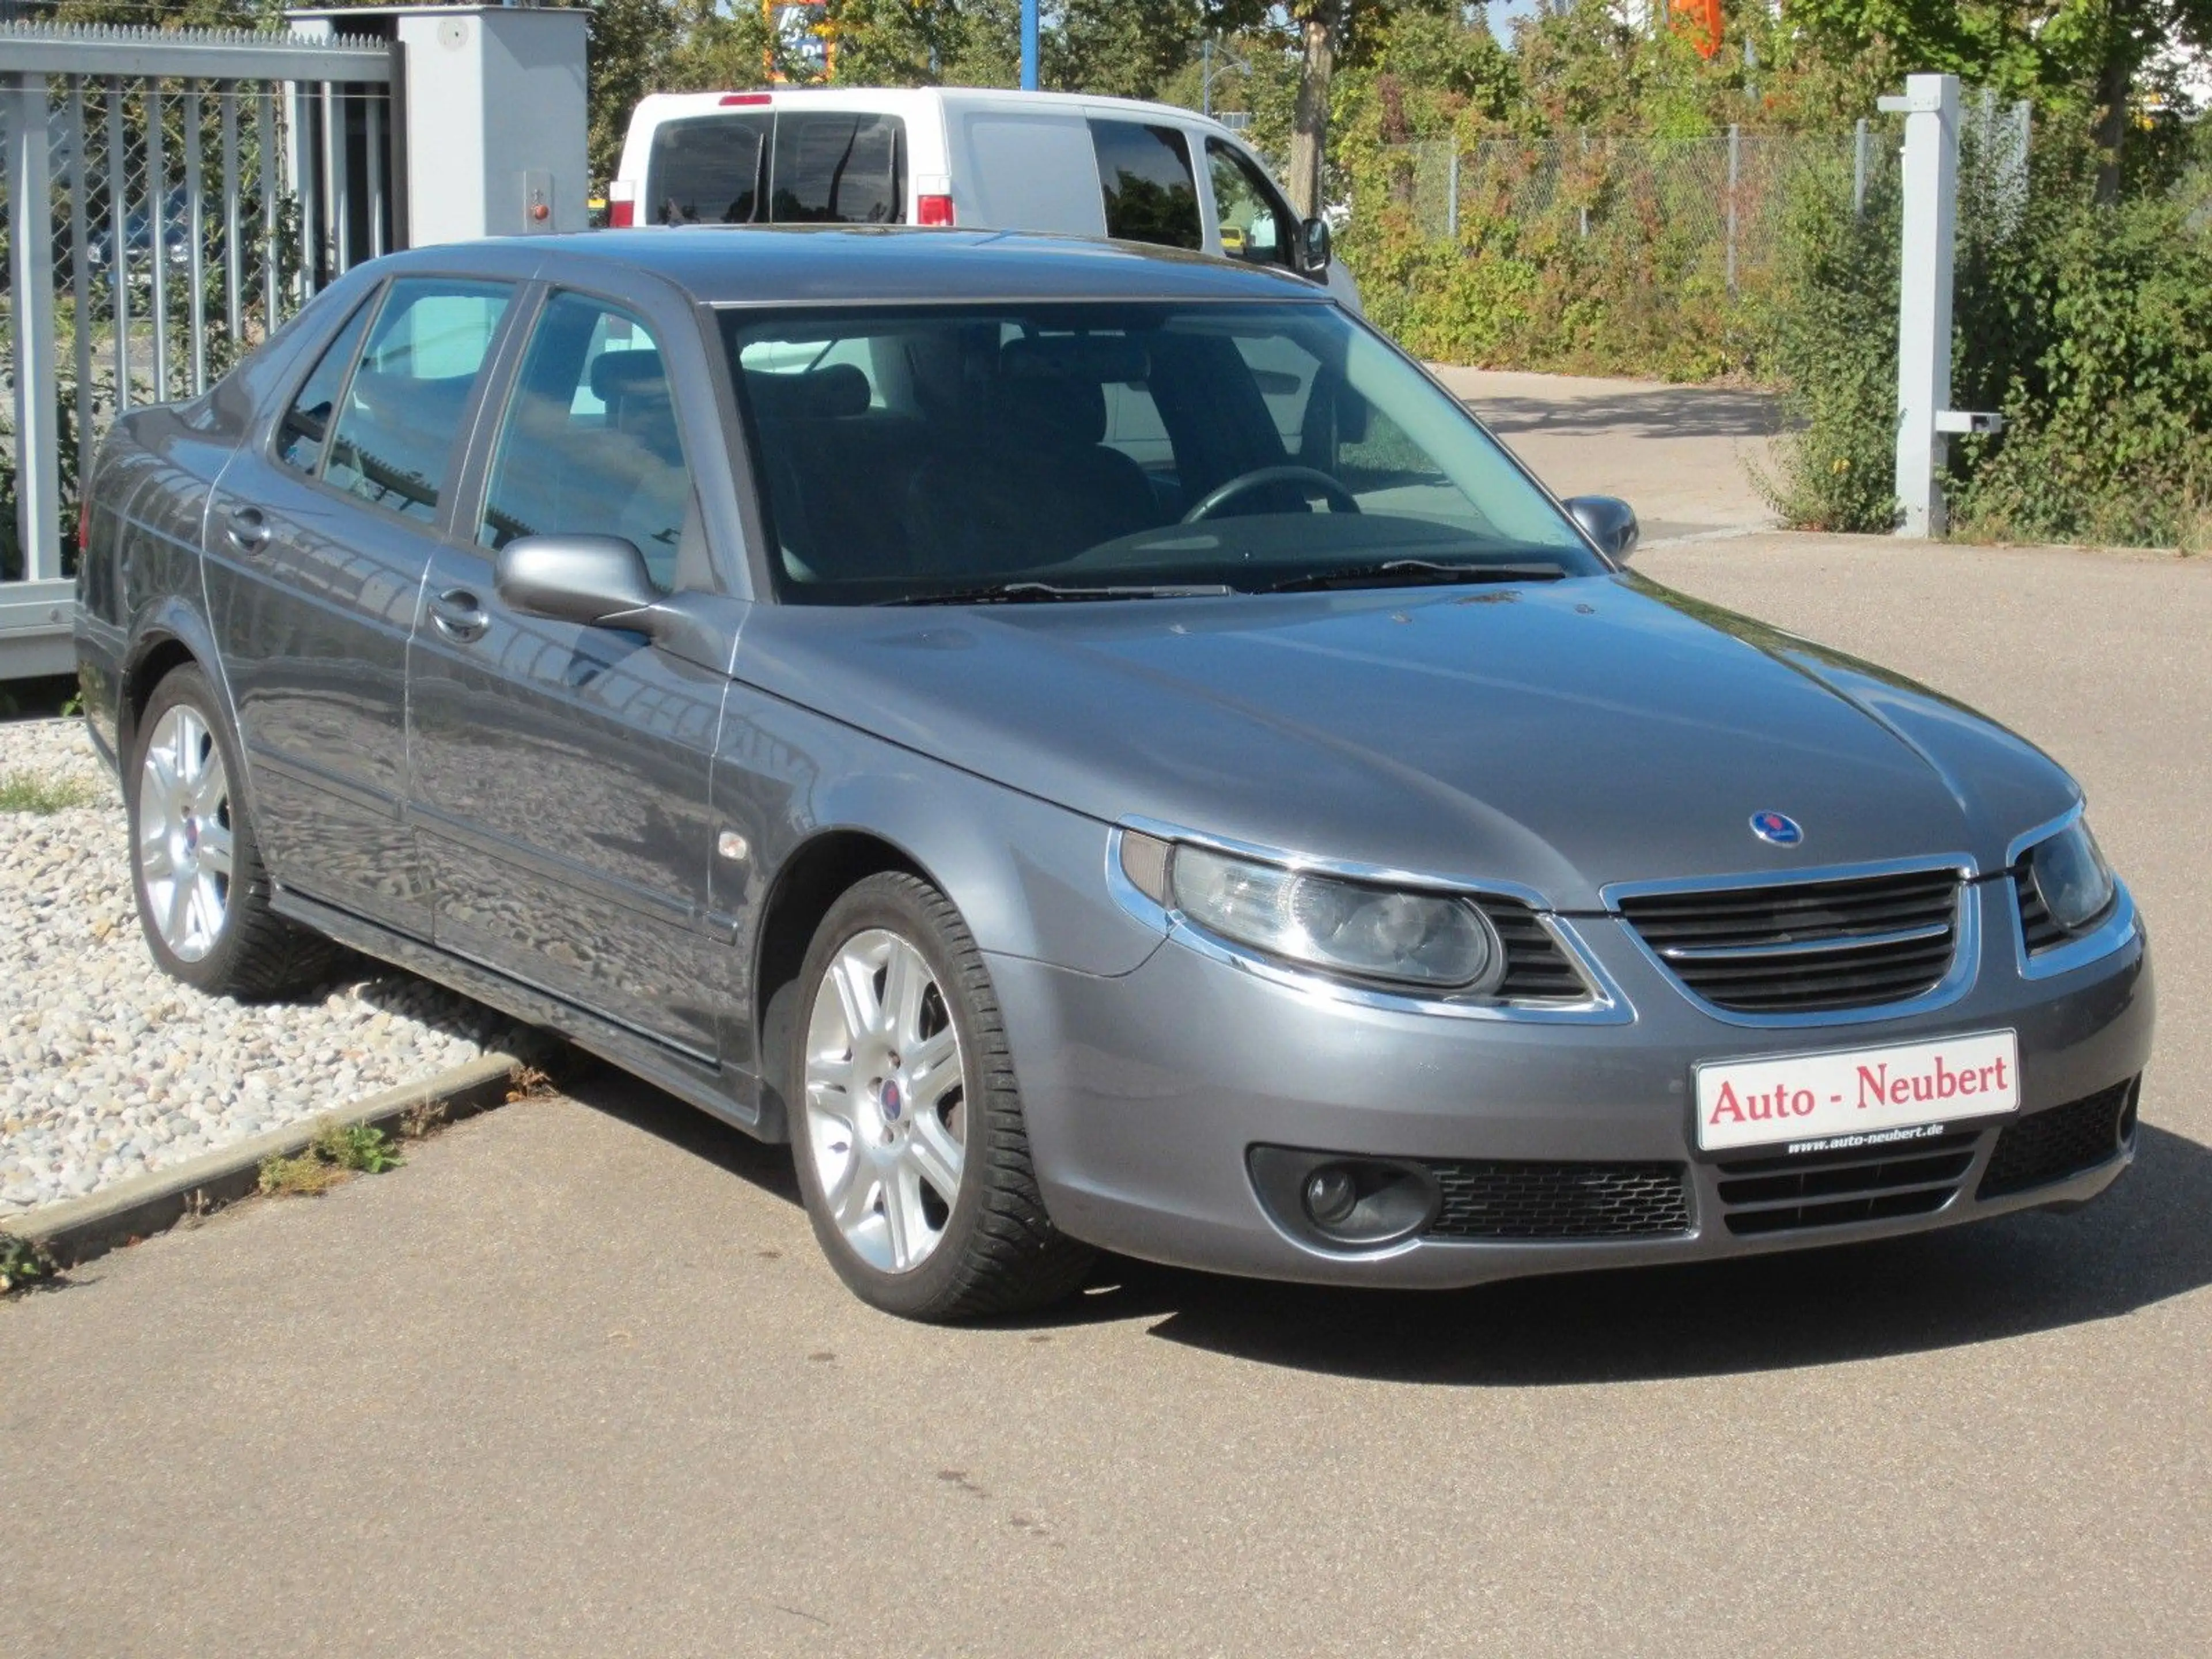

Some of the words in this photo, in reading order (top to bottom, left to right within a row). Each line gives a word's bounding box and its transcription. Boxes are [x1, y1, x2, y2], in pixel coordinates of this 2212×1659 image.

[1709, 1081, 1816, 1124] Auto
[1857, 1056, 2008, 1108] Neubert
[1788, 1123, 1944, 1153] www.auto-neubert.de
